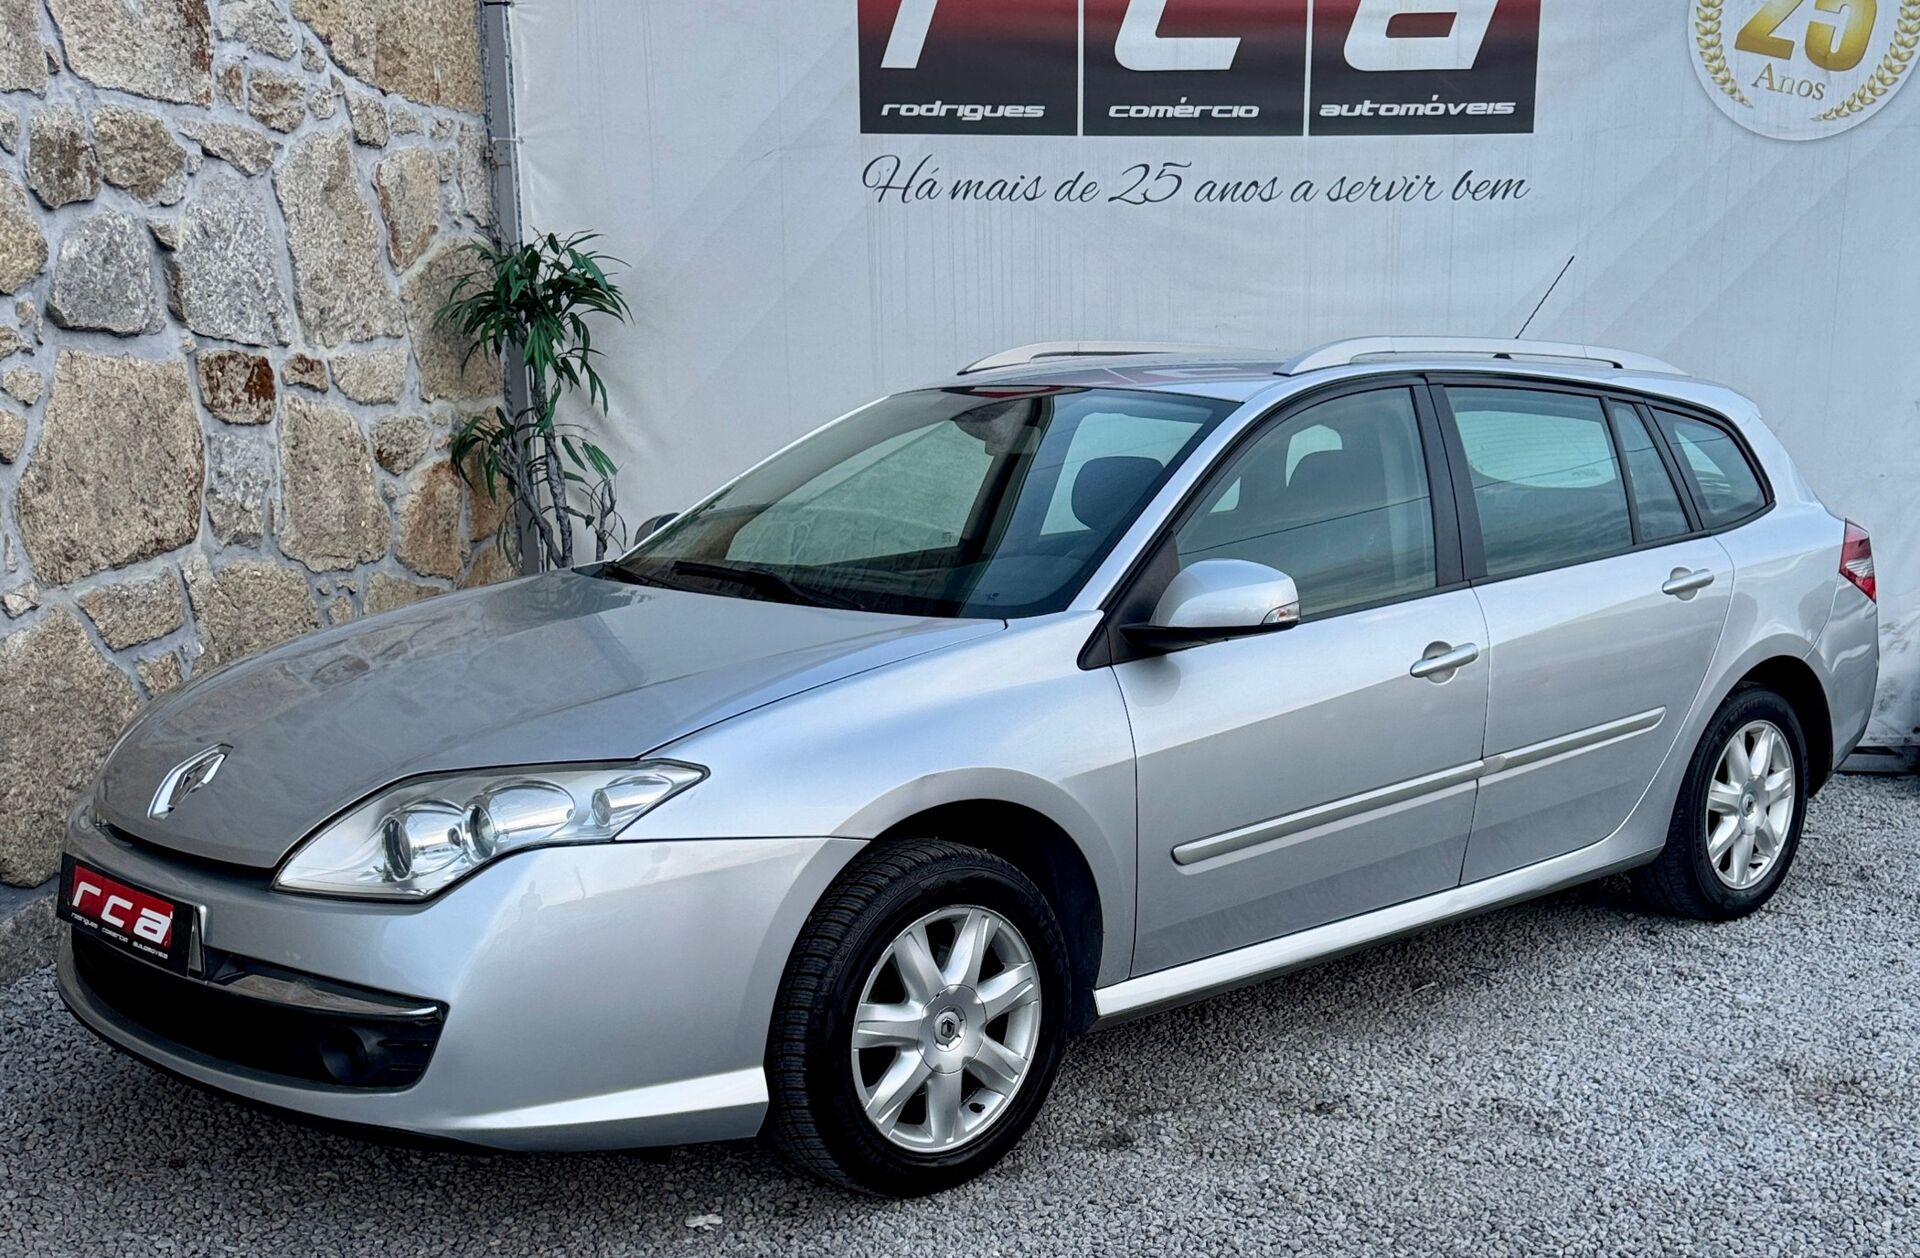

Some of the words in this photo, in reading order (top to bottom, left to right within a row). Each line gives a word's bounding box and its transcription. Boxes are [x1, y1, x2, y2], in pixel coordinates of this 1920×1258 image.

[1751, 62, 1826, 101] Anos
[881, 100, 1045, 121] rodrigues
[1108, 97, 1260, 119] comércio
[1319, 94, 1516, 117] automóveis
[861, 154, 941, 204] Há
[948, 174, 1046, 203] mais
[1055, 170, 1100, 203] de
[1107, 161, 1193, 205] 25
[1194, 178, 1283, 203] anos
[1289, 178, 1320, 202] a
[1325, 172, 1444, 202] servir
[1451, 168, 1531, 202] bem
[72, 881, 172, 944] rca
